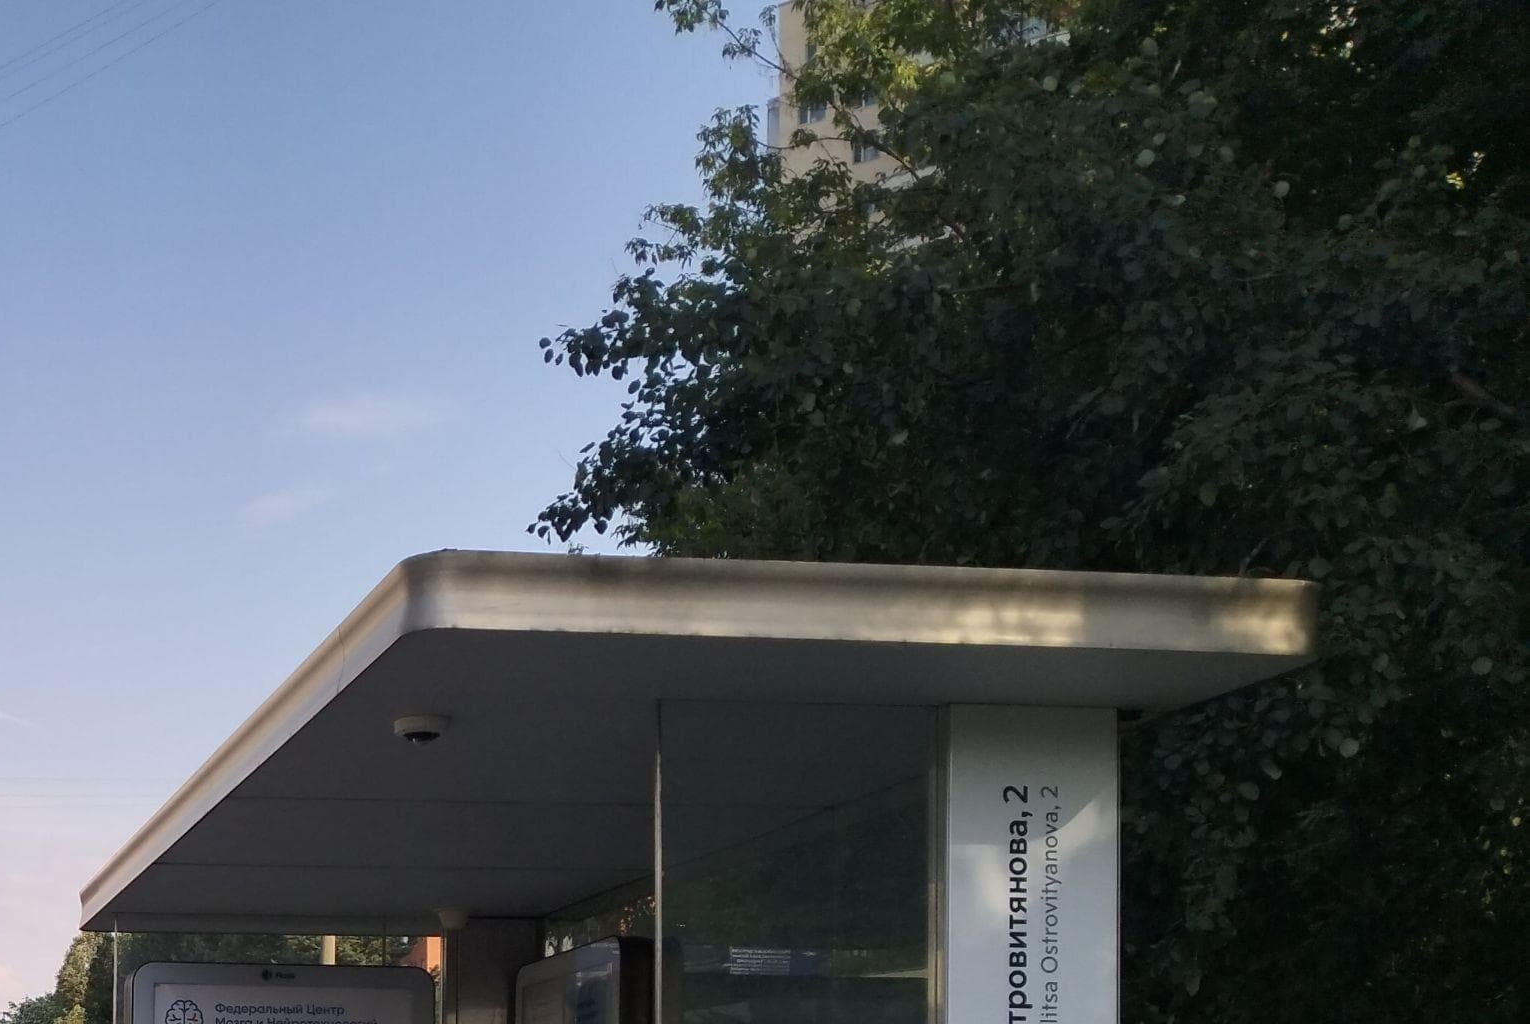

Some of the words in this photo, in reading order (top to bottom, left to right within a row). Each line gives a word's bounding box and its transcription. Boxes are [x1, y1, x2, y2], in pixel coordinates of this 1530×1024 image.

[1003, 784, 1029, 803] 2
[1041, 785, 1059, 798] 2
[1040, 805, 1062, 974] Ostrovityanova,
[215, 1004, 303, 1016] Федеральный
[306, 1004, 345, 1016] Центр
